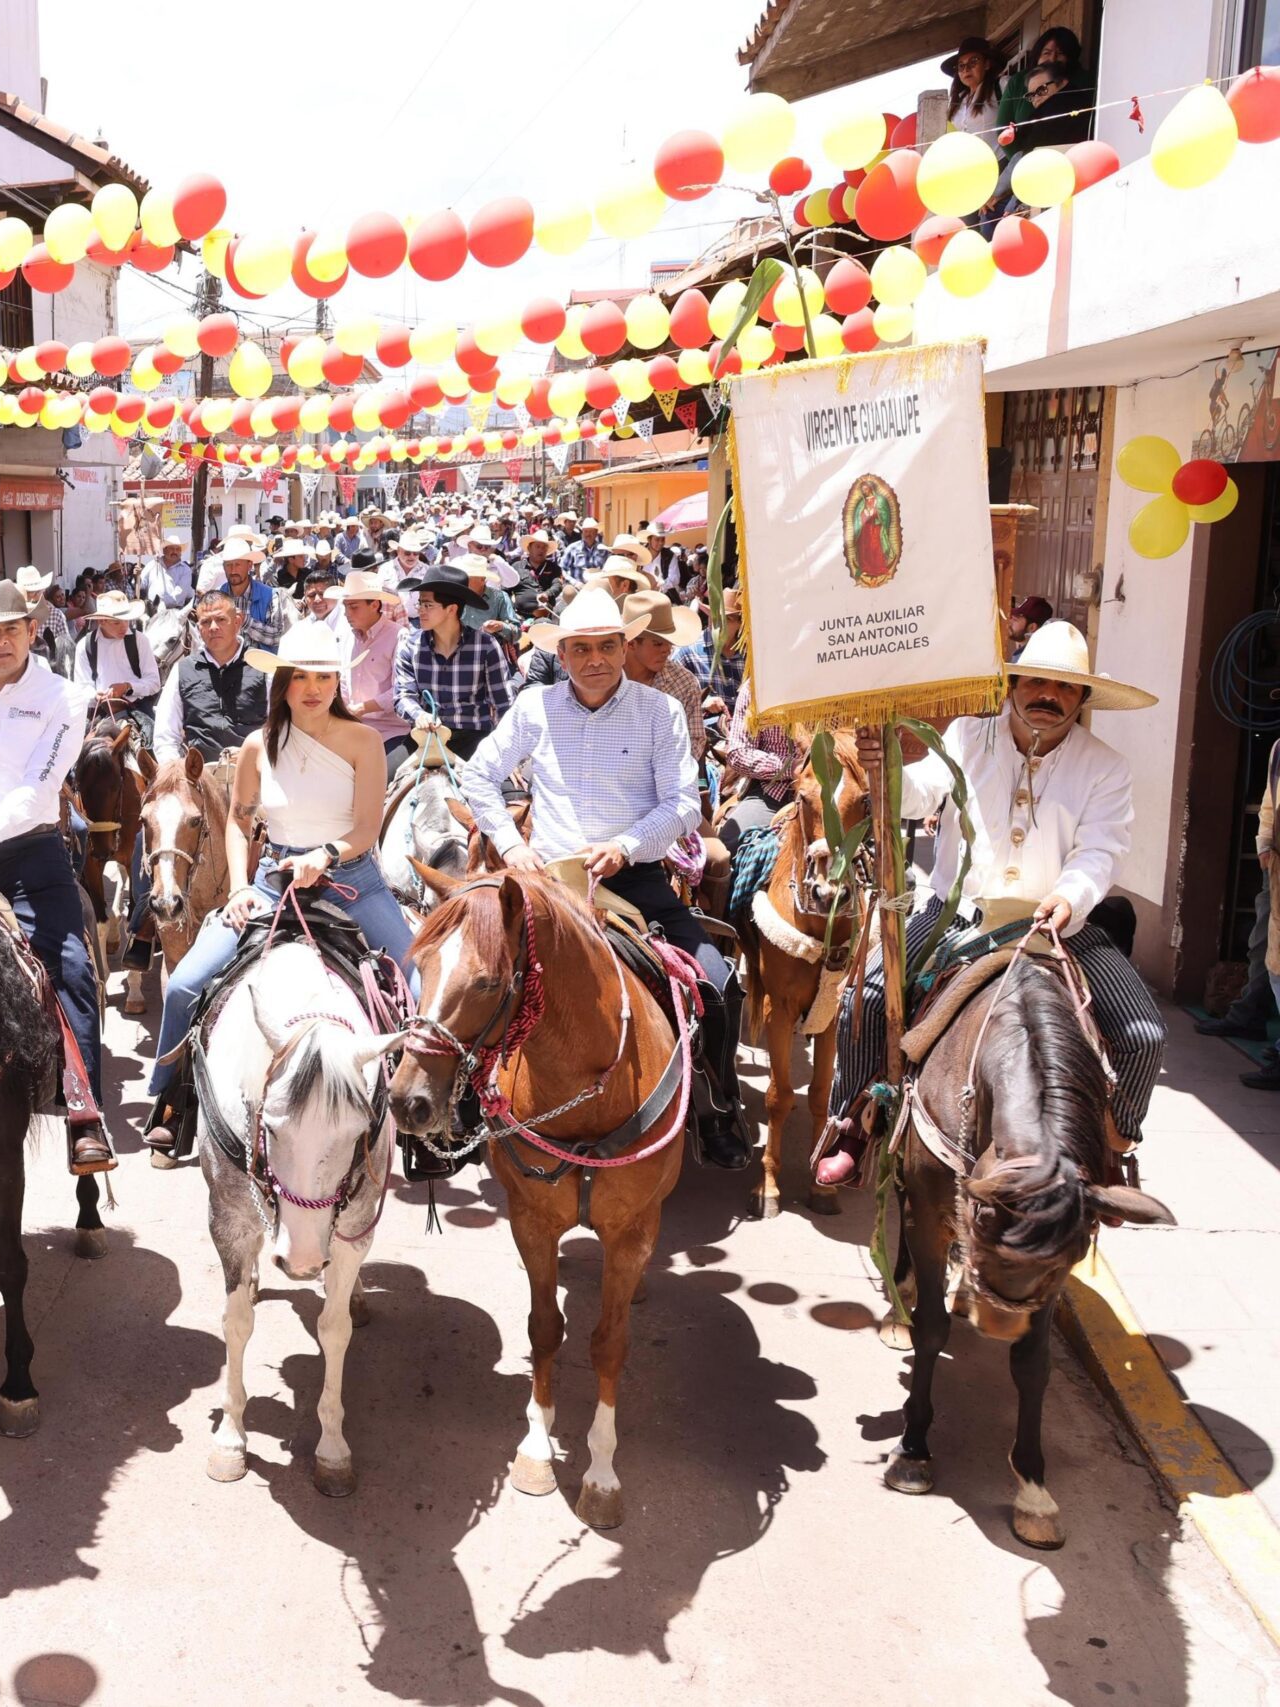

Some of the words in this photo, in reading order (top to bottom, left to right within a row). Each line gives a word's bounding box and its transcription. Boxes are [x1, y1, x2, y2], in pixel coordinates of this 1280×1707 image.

[803, 407, 843, 452] VIRGEN
[844, 403, 859, 446] DE
[859, 394, 922, 442] GUADALUPE
[819, 615, 863, 632] JUNTA
[866, 604, 925, 627] AUXILIAR
[827, 631, 856, 647] SAN
[858, 622, 919, 644] ANTONIO
[816, 635, 930, 664] MATLAHUACALES
[52, 723, 70, 752] Pensar
